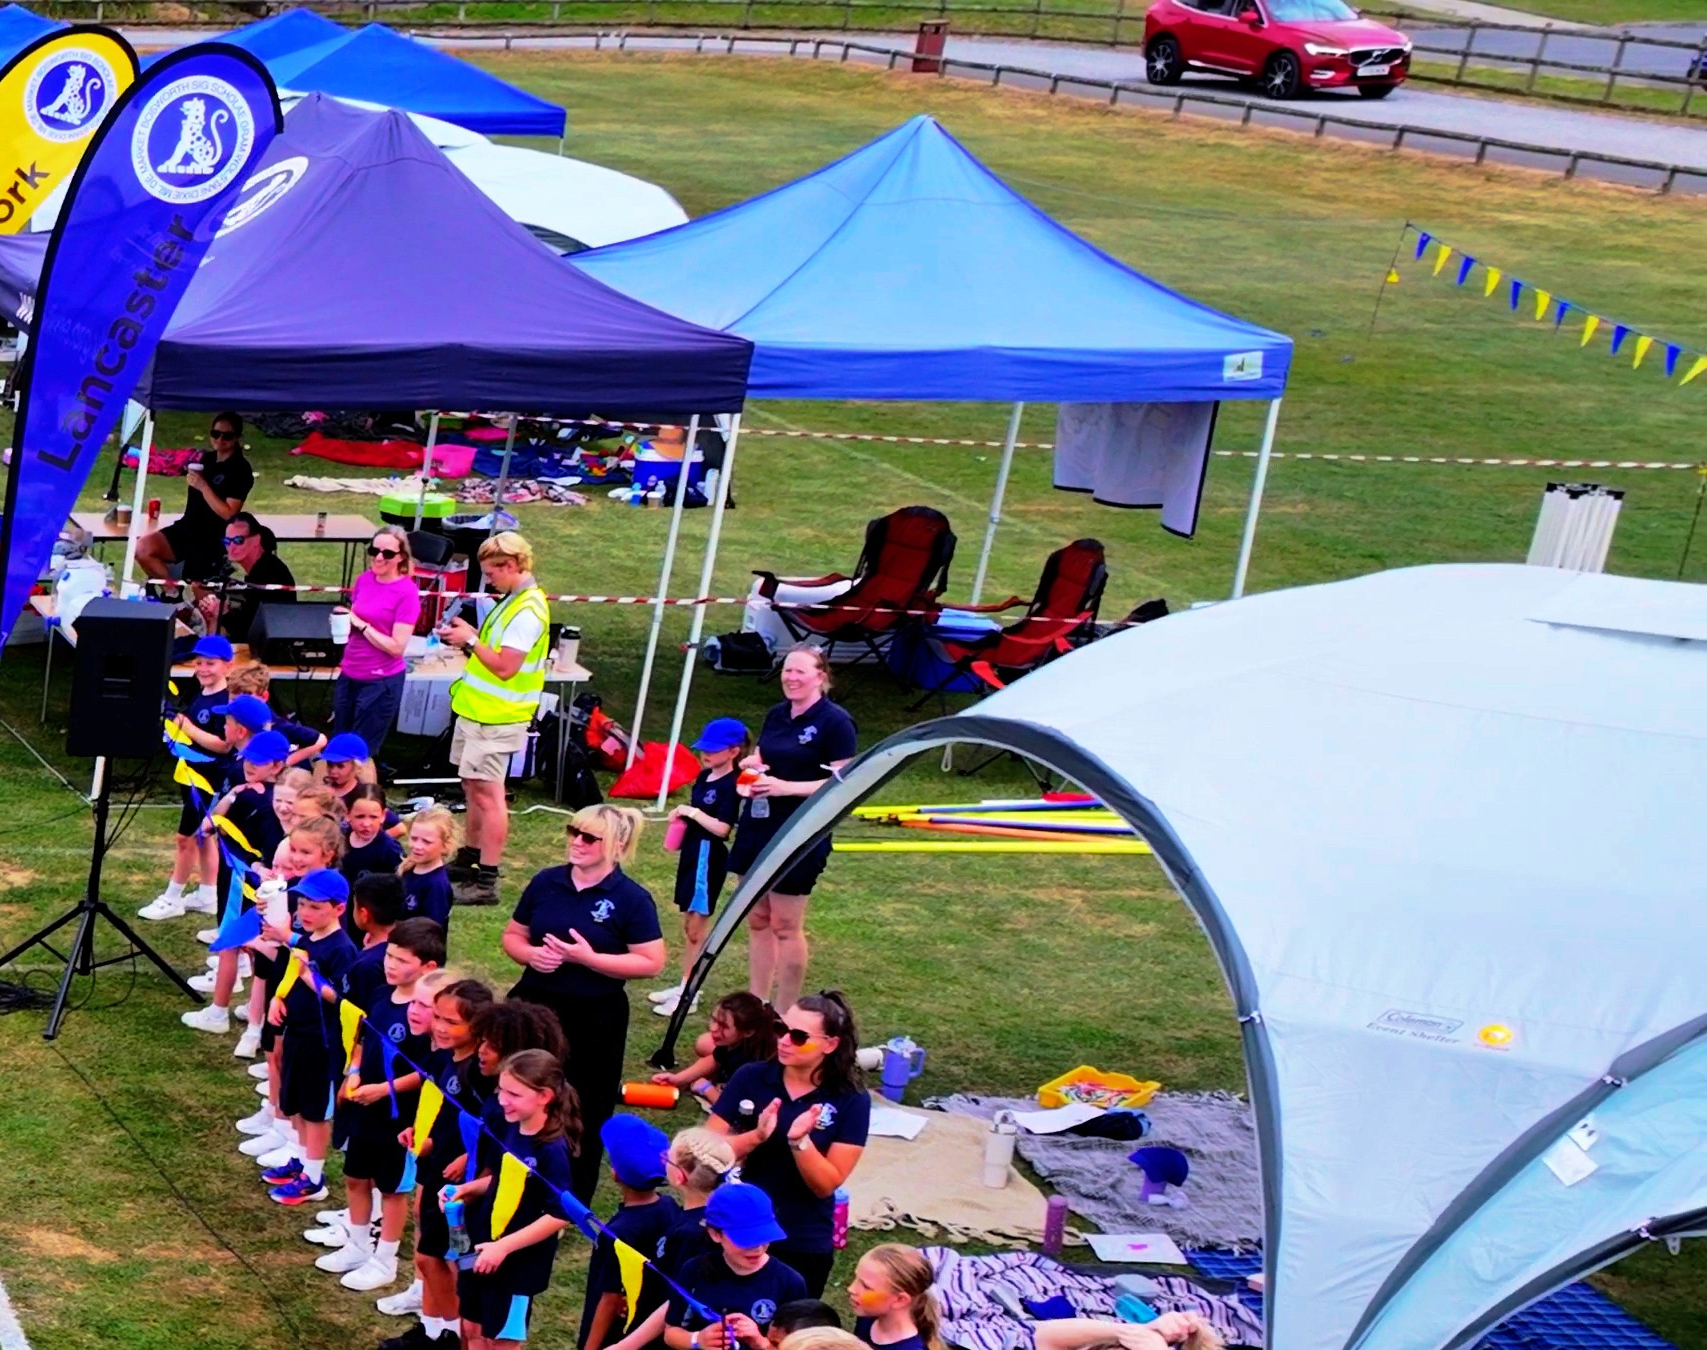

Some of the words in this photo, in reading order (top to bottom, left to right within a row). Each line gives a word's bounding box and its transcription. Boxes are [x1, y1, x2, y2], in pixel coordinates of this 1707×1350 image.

[191, 80, 209, 90] SIG
[140, 82, 189, 129] BOSWORTH
[136, 130, 148, 173] MARKET
[36, 213, 195, 472] Lancaster
[1366, 1022, 1406, 1035] Event
[1411, 1031, 1460, 1044] Shelter
[1387, 1012, 1443, 1027] Coleman
